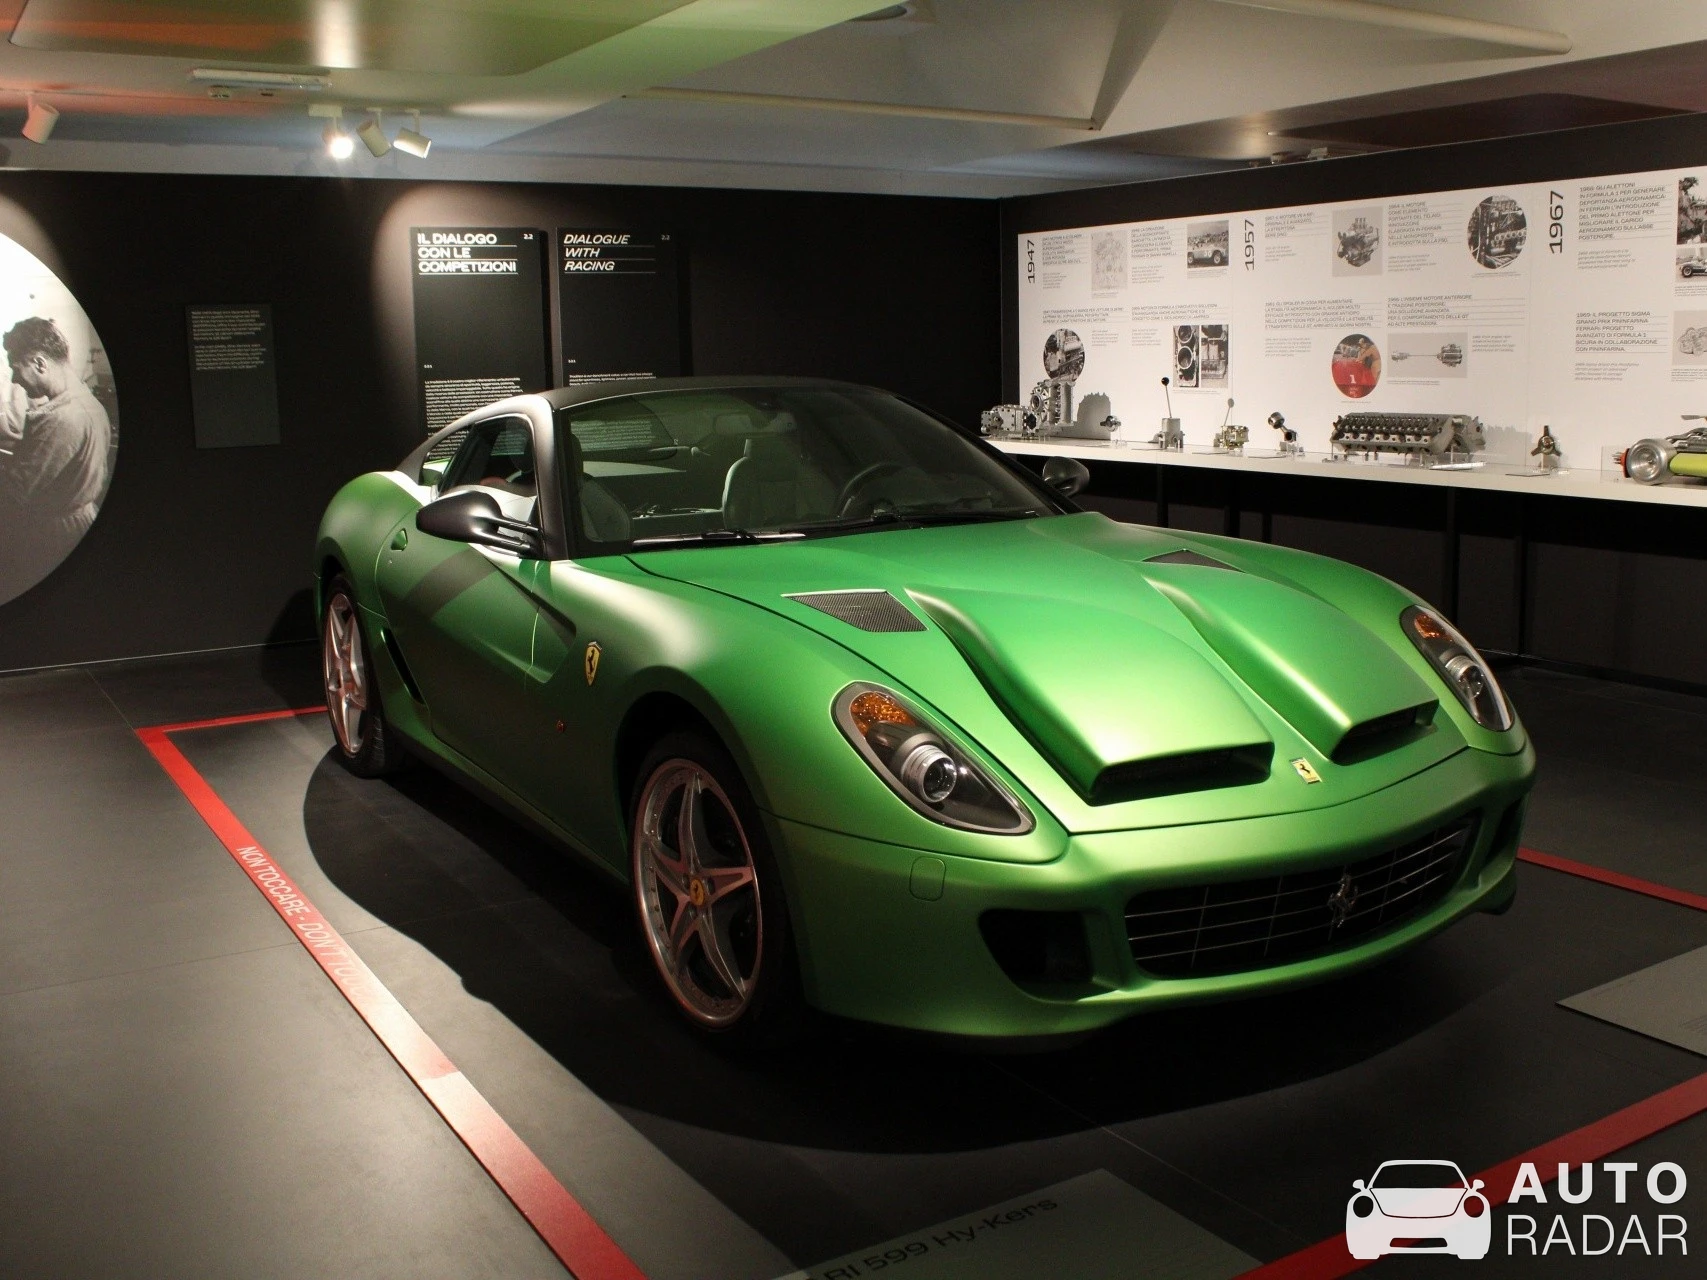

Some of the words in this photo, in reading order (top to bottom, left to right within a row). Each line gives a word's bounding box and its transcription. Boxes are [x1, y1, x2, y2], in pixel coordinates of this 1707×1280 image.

[1549, 191, 1564, 254] 1967
[418, 233, 430, 245] IL
[432, 233, 498, 245] DIALOGO
[563, 234, 631, 245] DIALOGUE
[1245, 220, 1255, 271] 1957
[418, 247, 450, 259] CON
[454, 247, 471, 259] LE
[565, 248, 600, 258] WITH
[419, 261, 517, 272] COMPETIZIONI
[564, 261, 615, 271] RACING
[1027, 240, 1035, 284] 1947
[236, 845, 267, 868] NON
[254, 866, 310, 916] TOCCARE
[863, 1241, 929, 1271] 599
[932, 1198, 1059, 1247] Hy-Kers
